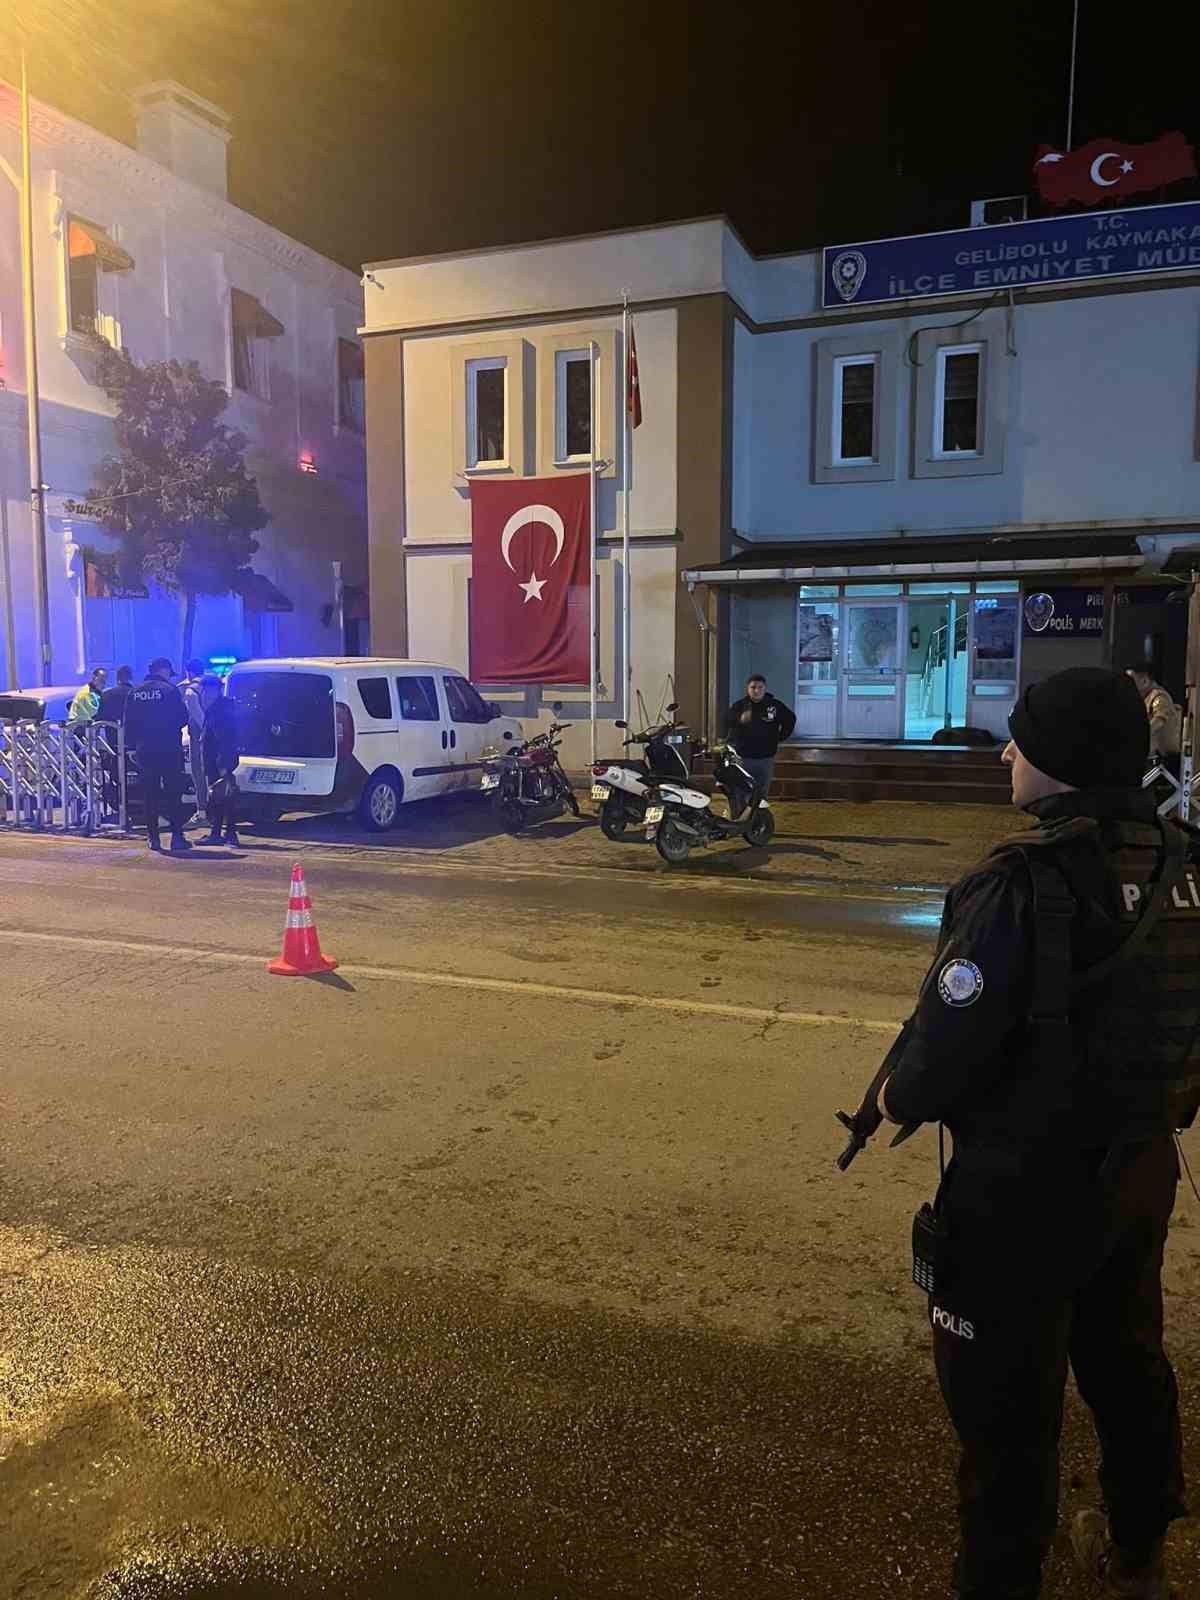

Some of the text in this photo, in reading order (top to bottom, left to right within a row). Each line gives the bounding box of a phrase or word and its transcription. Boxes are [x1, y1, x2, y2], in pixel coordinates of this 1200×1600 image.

[1094, 214, 1129, 231] T.C.
[955, 238, 1068, 265] GELİBOLU
[888, 273, 955, 296] İLÇE
[973, 254, 1115, 287] EMNİYET
[1050, 614, 1074, 631] POLİS
[1121, 872, 1200, 911] PLİ
[933, 1306, 975, 1340] POLİS
